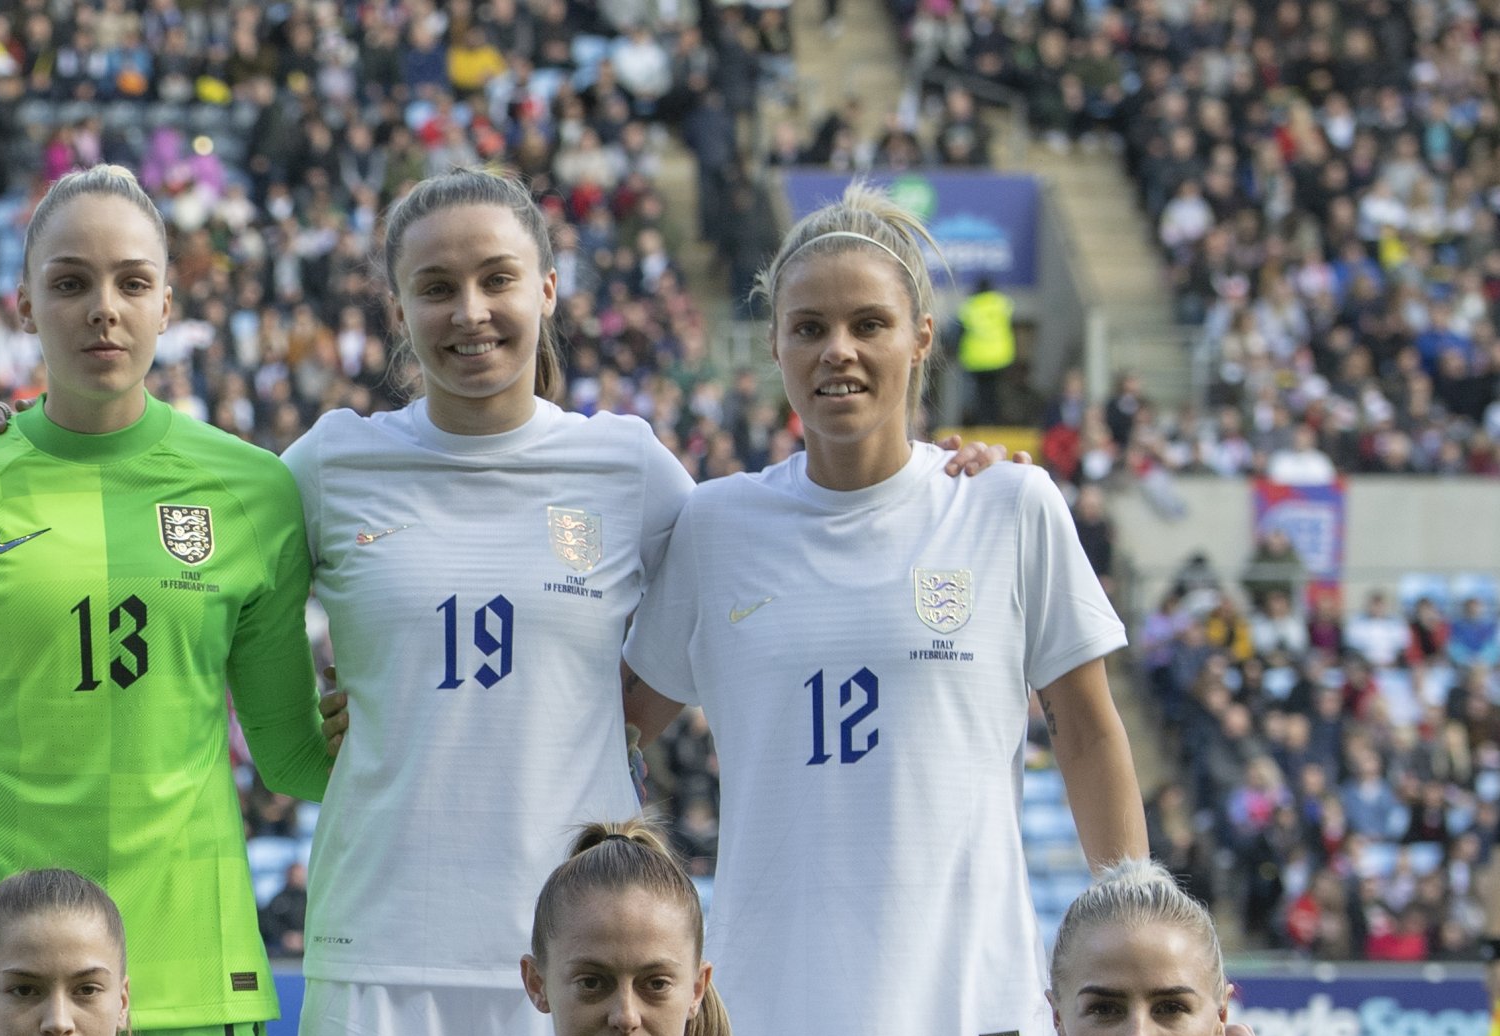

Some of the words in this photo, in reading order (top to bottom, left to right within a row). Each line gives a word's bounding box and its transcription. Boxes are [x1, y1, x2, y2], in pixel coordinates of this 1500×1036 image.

[566, 575, 587, 586] ITALY
[543, 582, 551, 591] 19
[553, 583, 589, 597] FEBRUARY
[71, 594, 148, 691] 13
[437, 595, 513, 690] 19
[932, 640, 955, 650] ITALY
[909, 650, 918, 660] 19
[919, 650, 959, 661] FEBRUARY
[805, 667, 878, 765] 12
